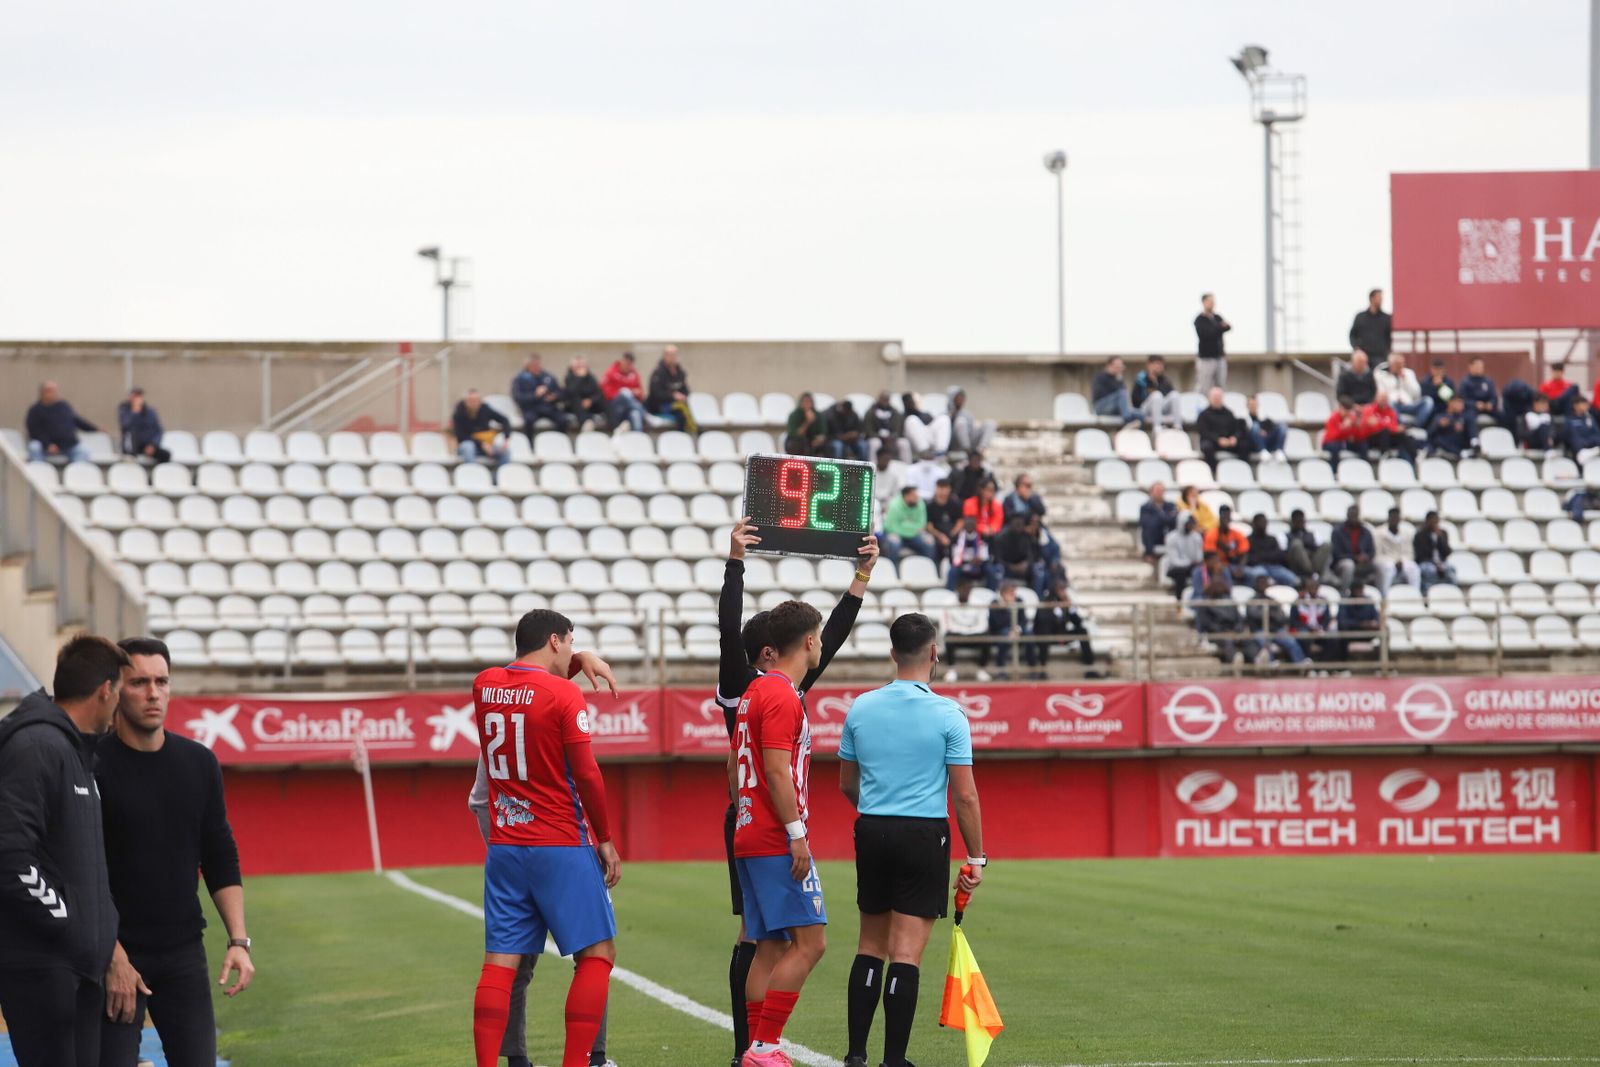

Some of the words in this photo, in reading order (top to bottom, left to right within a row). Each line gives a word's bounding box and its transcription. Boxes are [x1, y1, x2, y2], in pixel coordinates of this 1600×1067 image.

[1234, 694, 1315, 713] GETARES
[1318, 692, 1386, 712] MOTOR
[1465, 690, 1545, 710] GETARES
[252, 707, 417, 742] CaixaBank
[1028, 717, 1073, 733] Puerta
[1074, 717, 1122, 736] Europa
[1234, 716, 1283, 733] CAMPO
[1285, 716, 1302, 732] DE
[1304, 715, 1376, 731] GIBRALTAR
[1464, 713, 1514, 730] CAMPO
[1515, 713, 1534, 729] DE
[484, 712, 529, 781] 21
[1254, 770, 1356, 813] 威视
[1457, 768, 1559, 811] 威视
[1176, 818, 1357, 847] NUCTECH
[1379, 816, 1560, 845] NUCTECH
